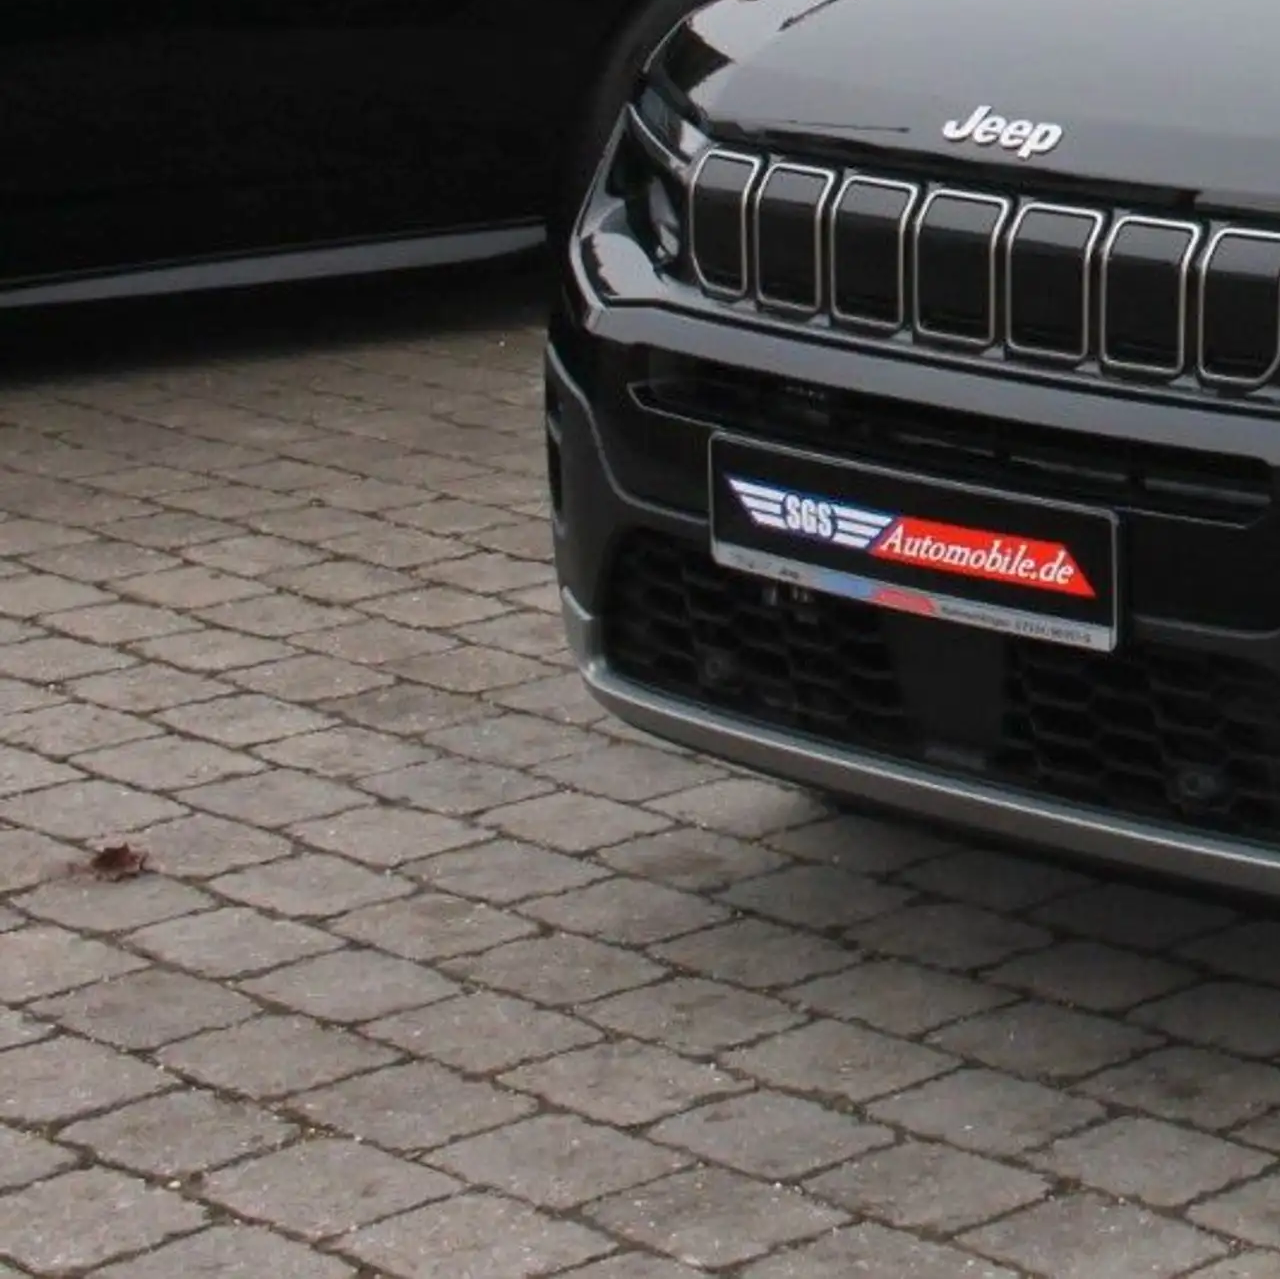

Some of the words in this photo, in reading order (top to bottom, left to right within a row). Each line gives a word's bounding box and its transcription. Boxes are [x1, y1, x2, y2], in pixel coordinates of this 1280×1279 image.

[942, 105, 1063, 160] Jeep
[786, 494, 834, 538] SGS
[879, 524, 1074, 585] Automobile.de
